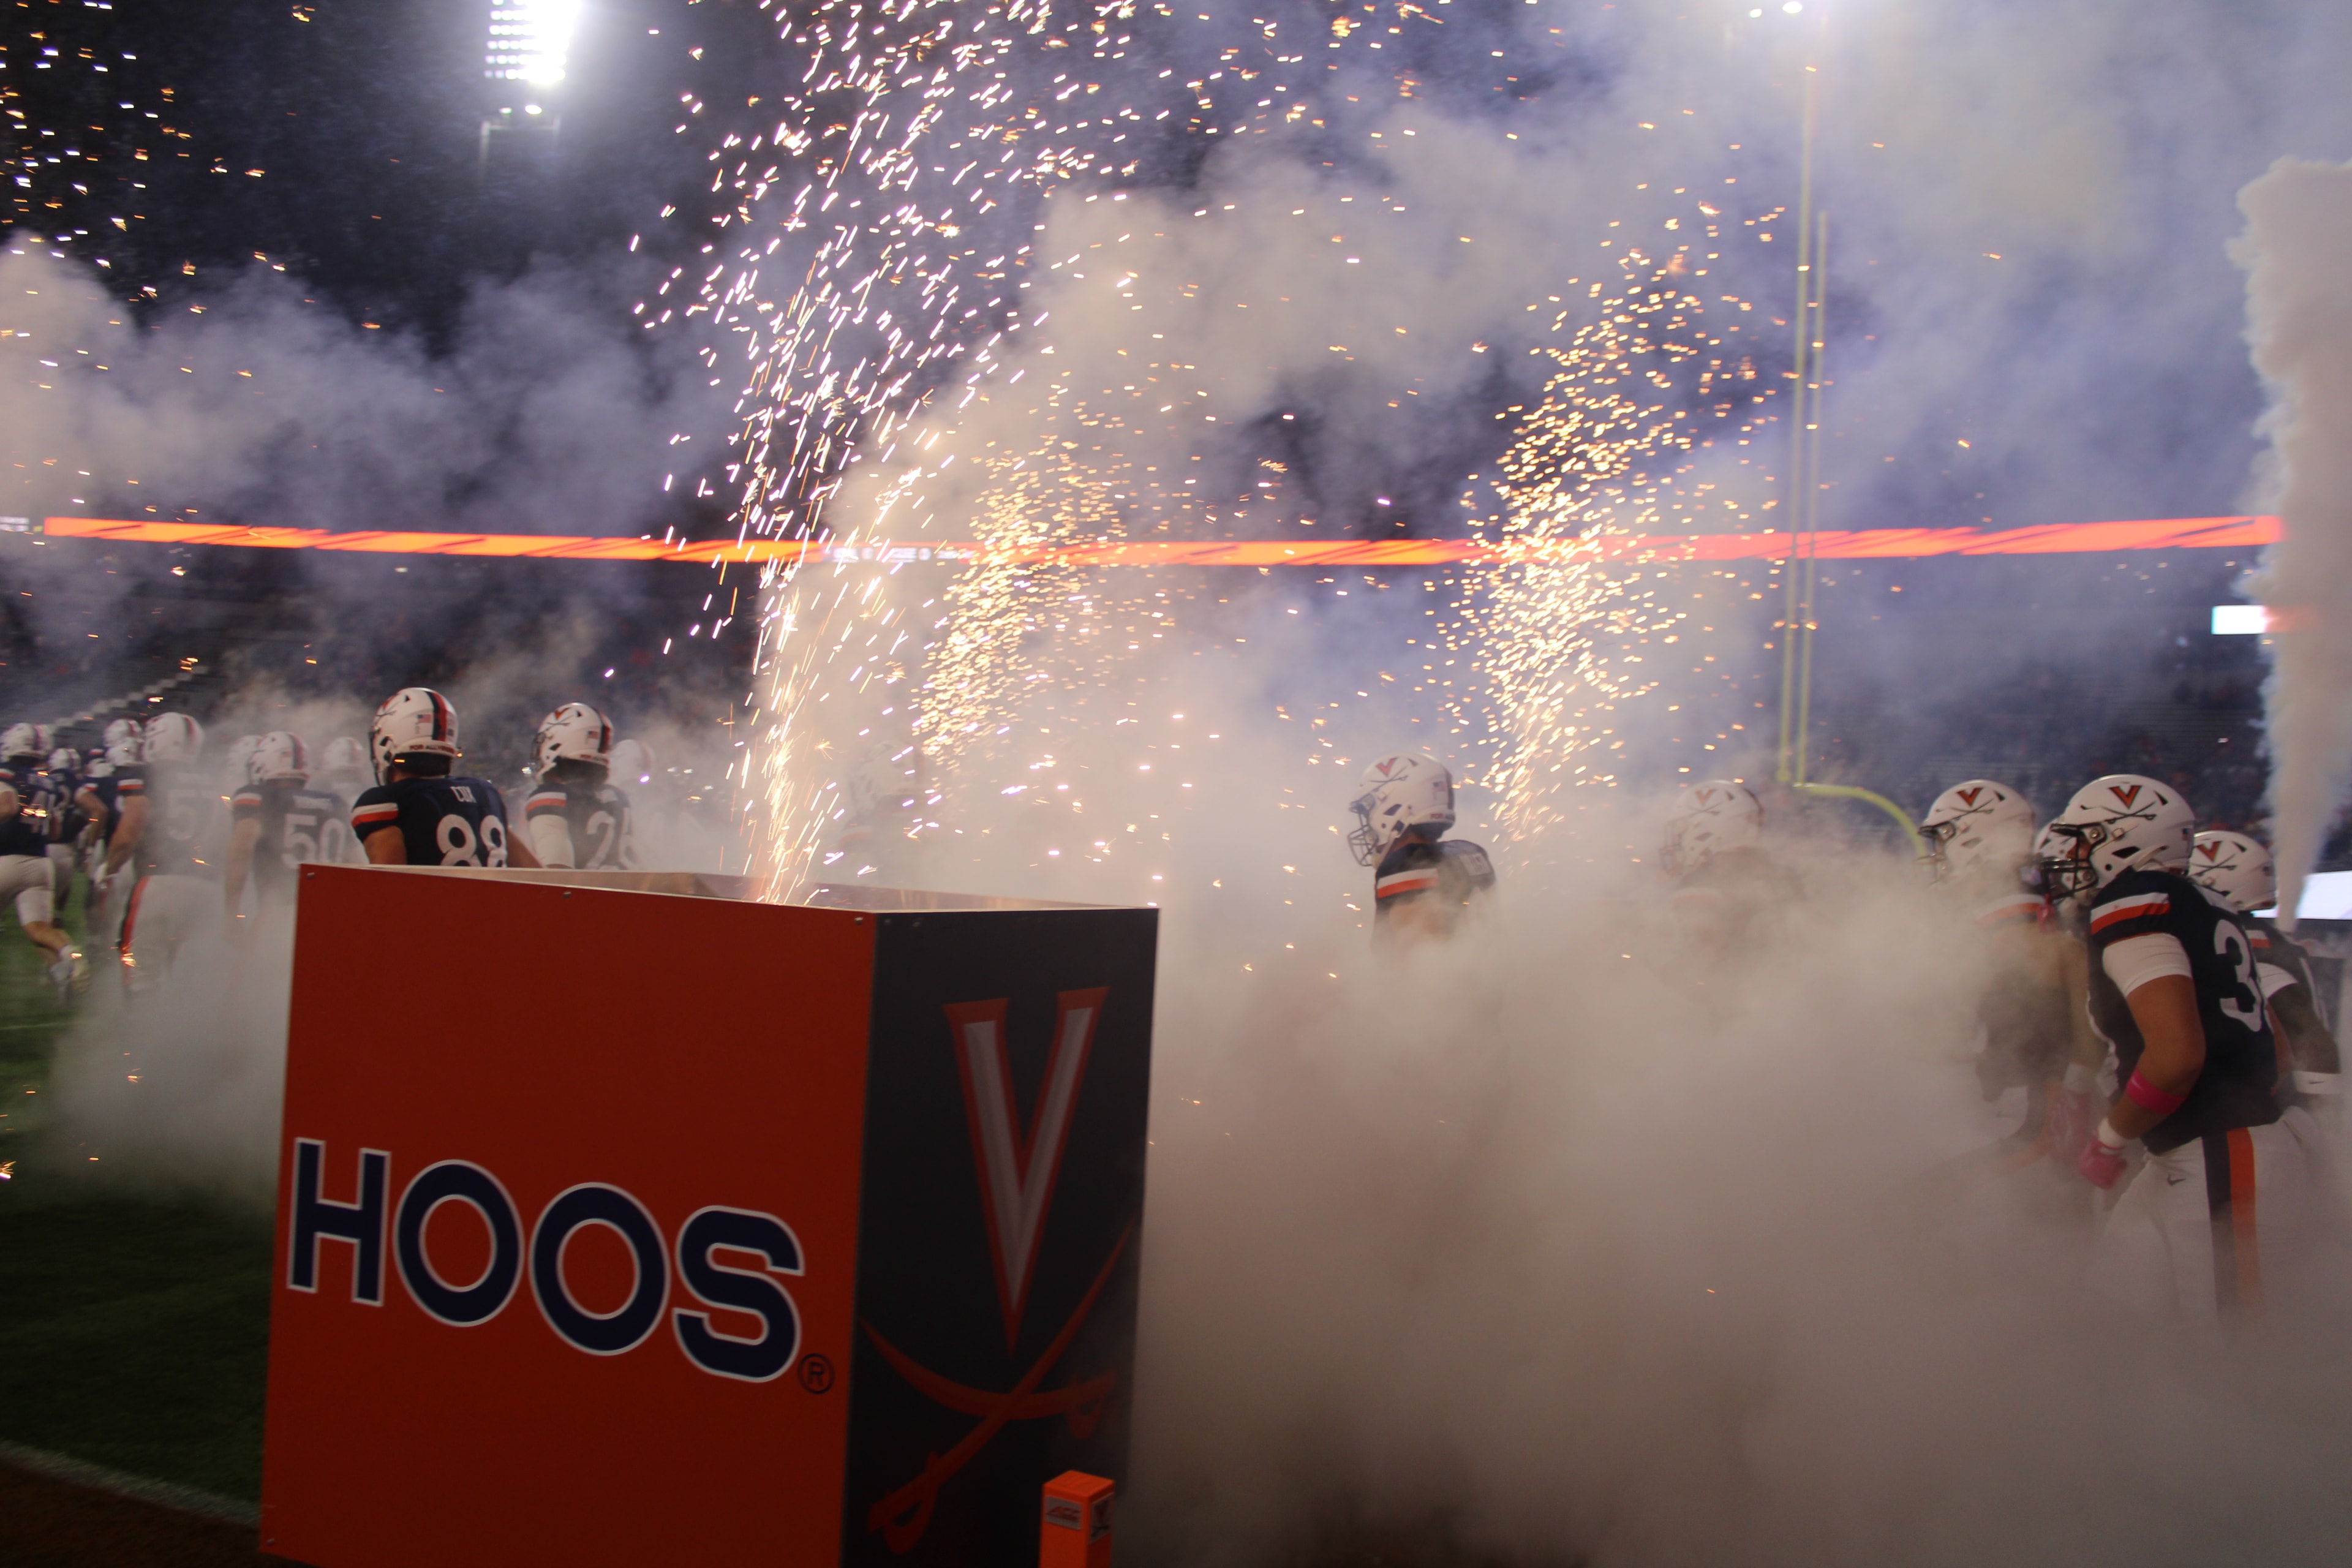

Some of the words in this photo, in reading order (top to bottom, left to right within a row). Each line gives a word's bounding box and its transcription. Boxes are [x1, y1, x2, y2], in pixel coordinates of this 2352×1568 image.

[282, 813, 345, 869] 50
[435, 813, 508, 867] 88
[286, 1136, 805, 1384] HOOS
